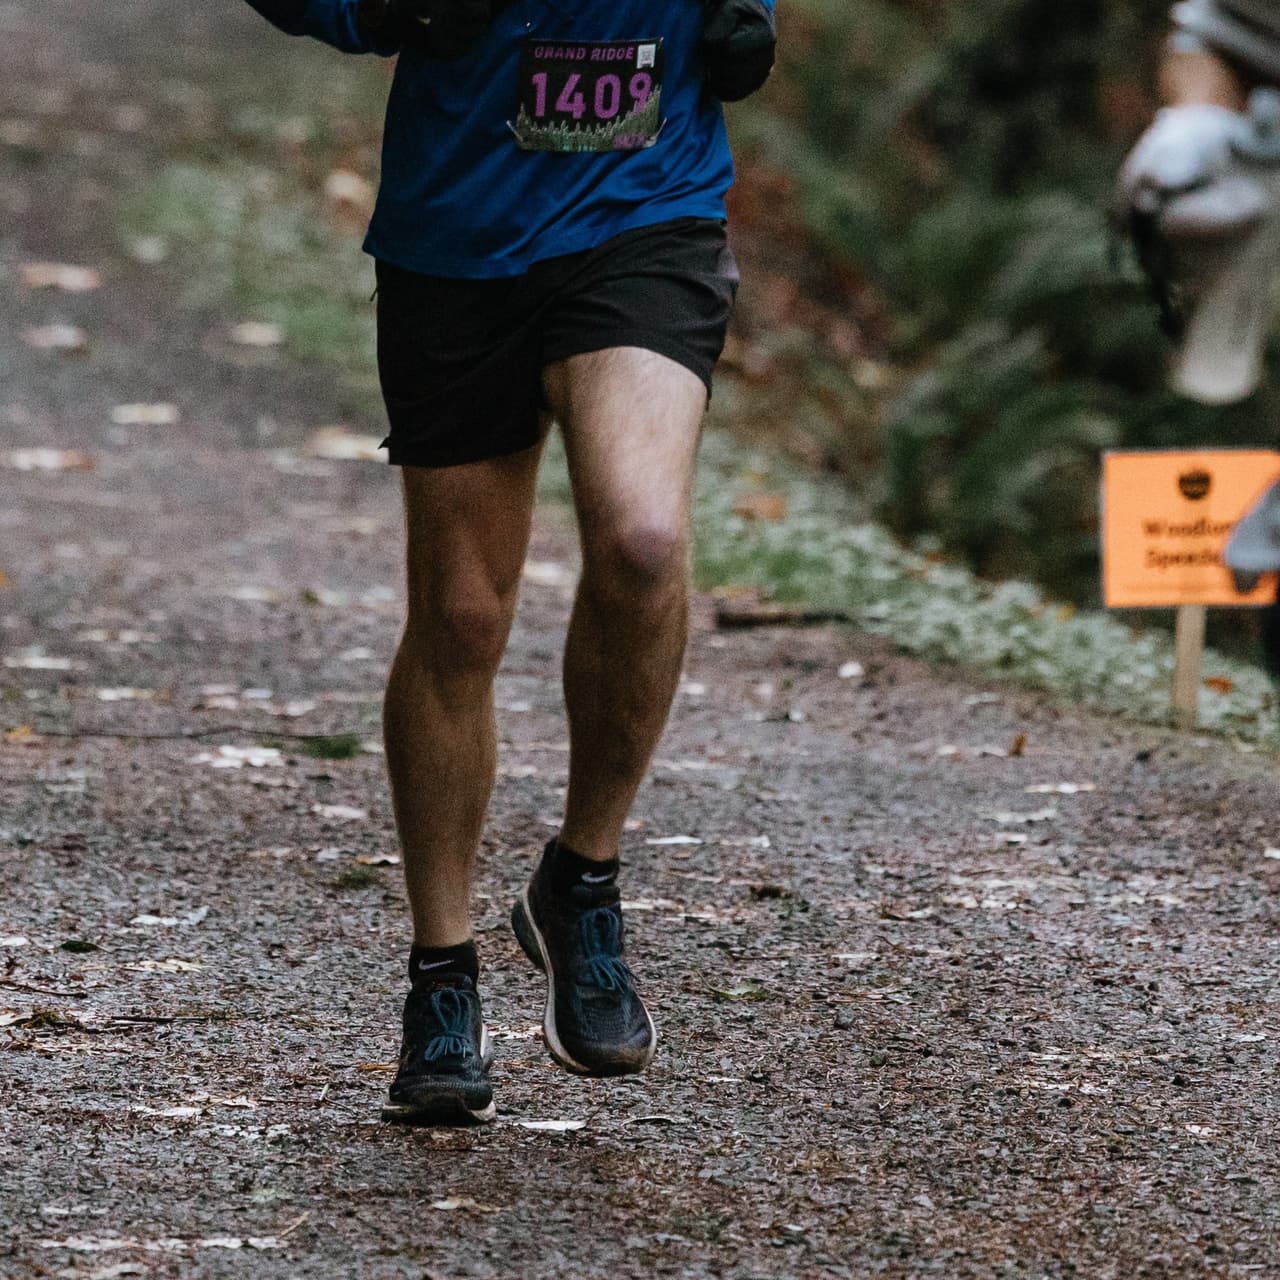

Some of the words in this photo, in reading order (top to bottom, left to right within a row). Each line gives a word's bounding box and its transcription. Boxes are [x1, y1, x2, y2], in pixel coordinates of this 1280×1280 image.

[534, 46, 587, 61] GRAND
[590, 46, 634, 61] RIDGE
[531, 71, 653, 120] 1409
